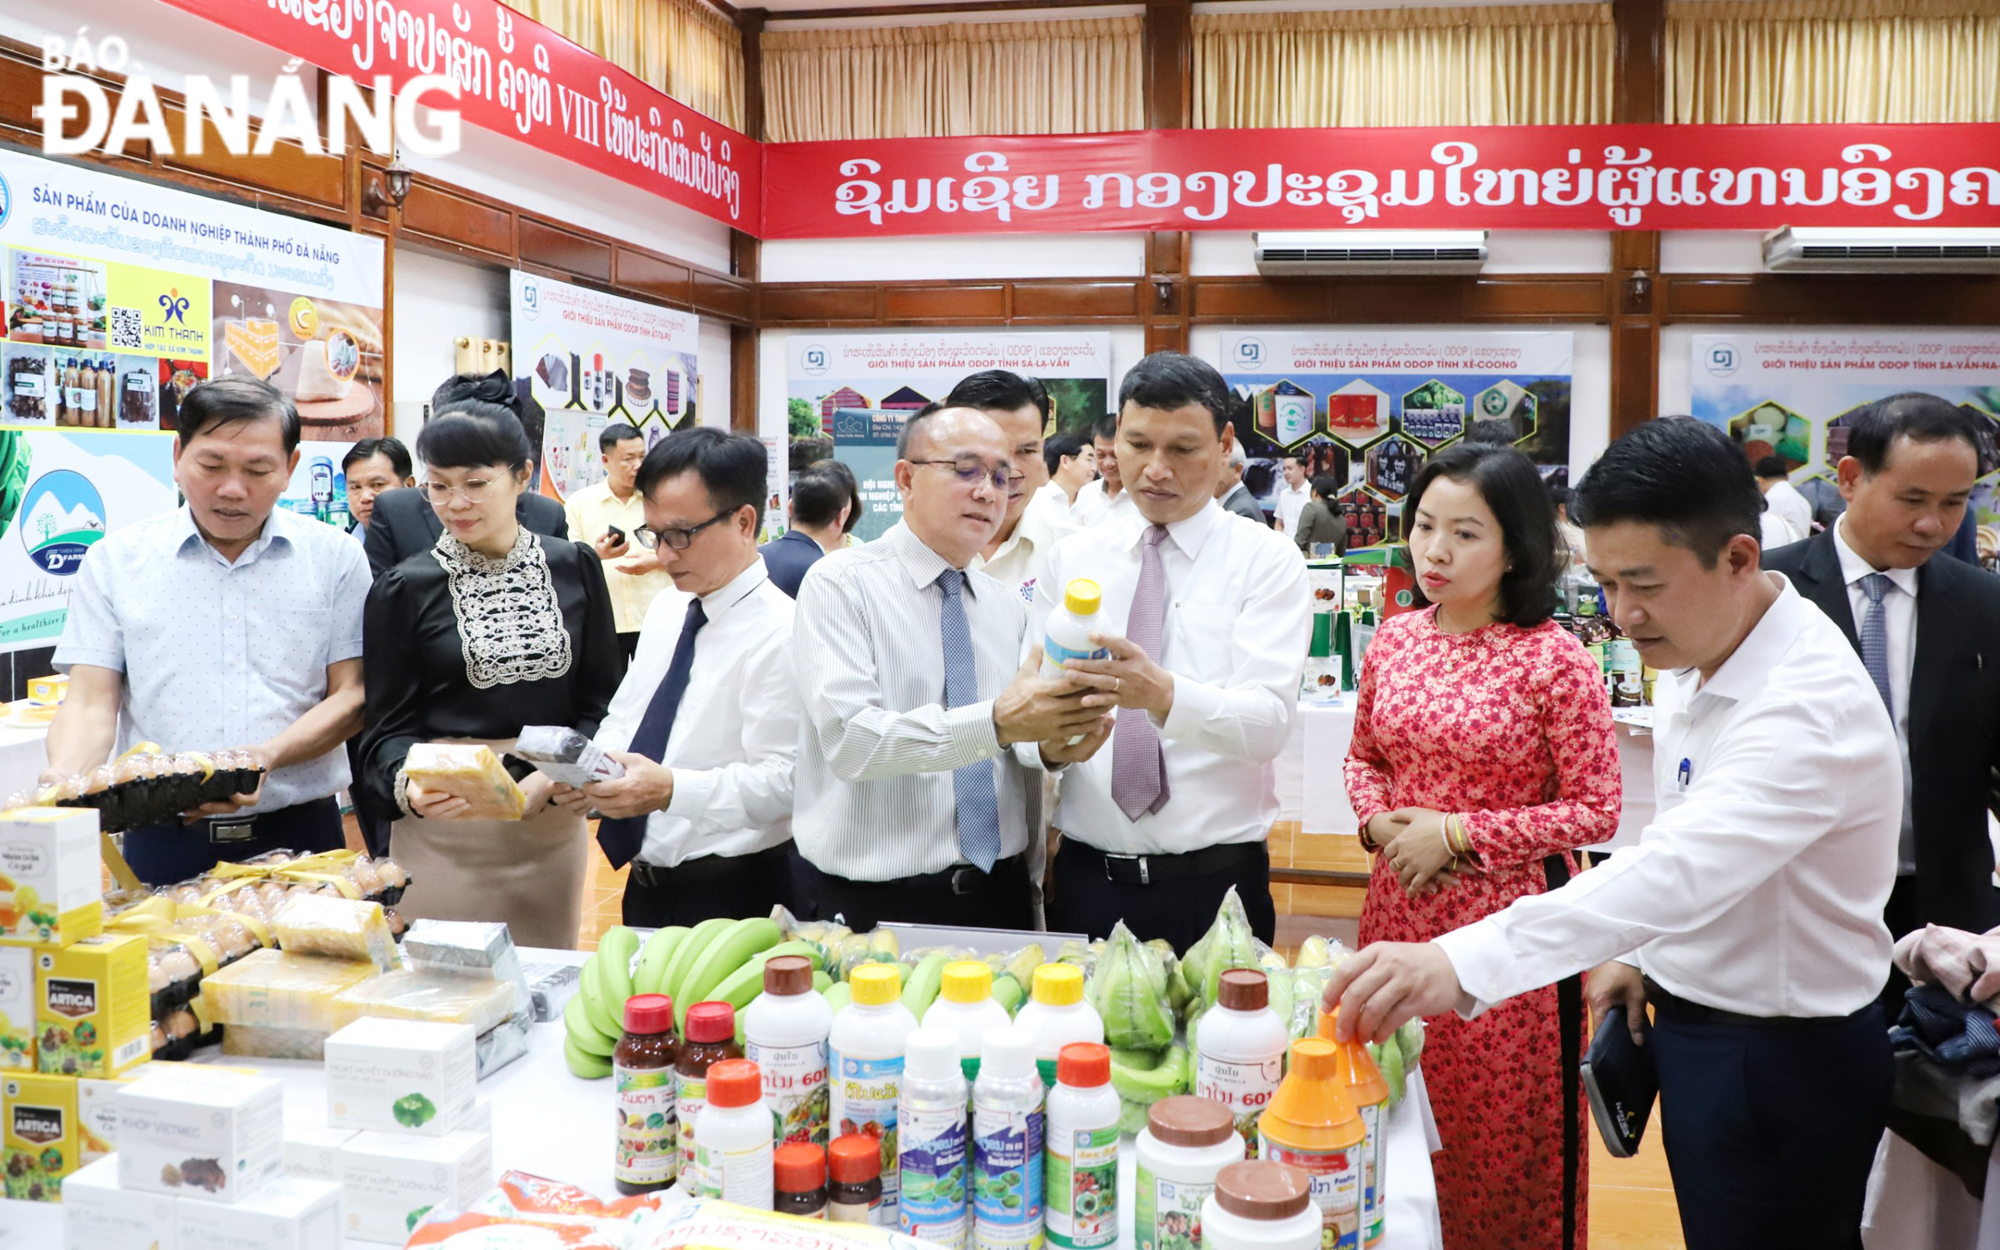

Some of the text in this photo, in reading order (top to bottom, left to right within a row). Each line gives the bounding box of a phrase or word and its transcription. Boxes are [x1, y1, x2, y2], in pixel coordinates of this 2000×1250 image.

[557, 84, 600, 147] VIII
[32, 183, 340, 265] SẢN PHẨM CỦA DOANH NGHIỆP THÀNH PHỐ ĐÀ NẴNG
[145, 324, 204, 342] KIM THANH
[867, 359, 888, 369] GIỚI
[891, 359, 915, 370] THIỆU
[918, 358, 936, 369] SẢN
[938, 357, 965, 369] PHẨM
[968, 359, 995, 369] ODOP
[998, 358, 1019, 369] TỈNH
[1294, 359, 1316, 369] GIỚI
[1319, 359, 1346, 370] THIỆU
[1348, 358, 1368, 369] SẢN
[1372, 357, 1401, 369] PHẨM
[1404, 360, 1434, 369] ODOP
[1436, 359, 1459, 369] TỈNH
[1762, 360, 1786, 369] GIỚI
[1789, 360, 1817, 370] THIỆU
[1820, 359, 1841, 369] SẢN
[1844, 357, 1875, 369] PHẨM
[1879, 360, 1910, 369] ODOP
[1913, 359, 1937, 369] TỈNH
[863, 479, 876, 491] HỘI
[868, 490, 896, 503] NGHIỆP
[873, 501, 888, 513] CÁC
[22, 604, 59, 633] healthier
[50, 993, 93, 1007] ARTICA
[16, 1119, 60, 1134] ARTICA
